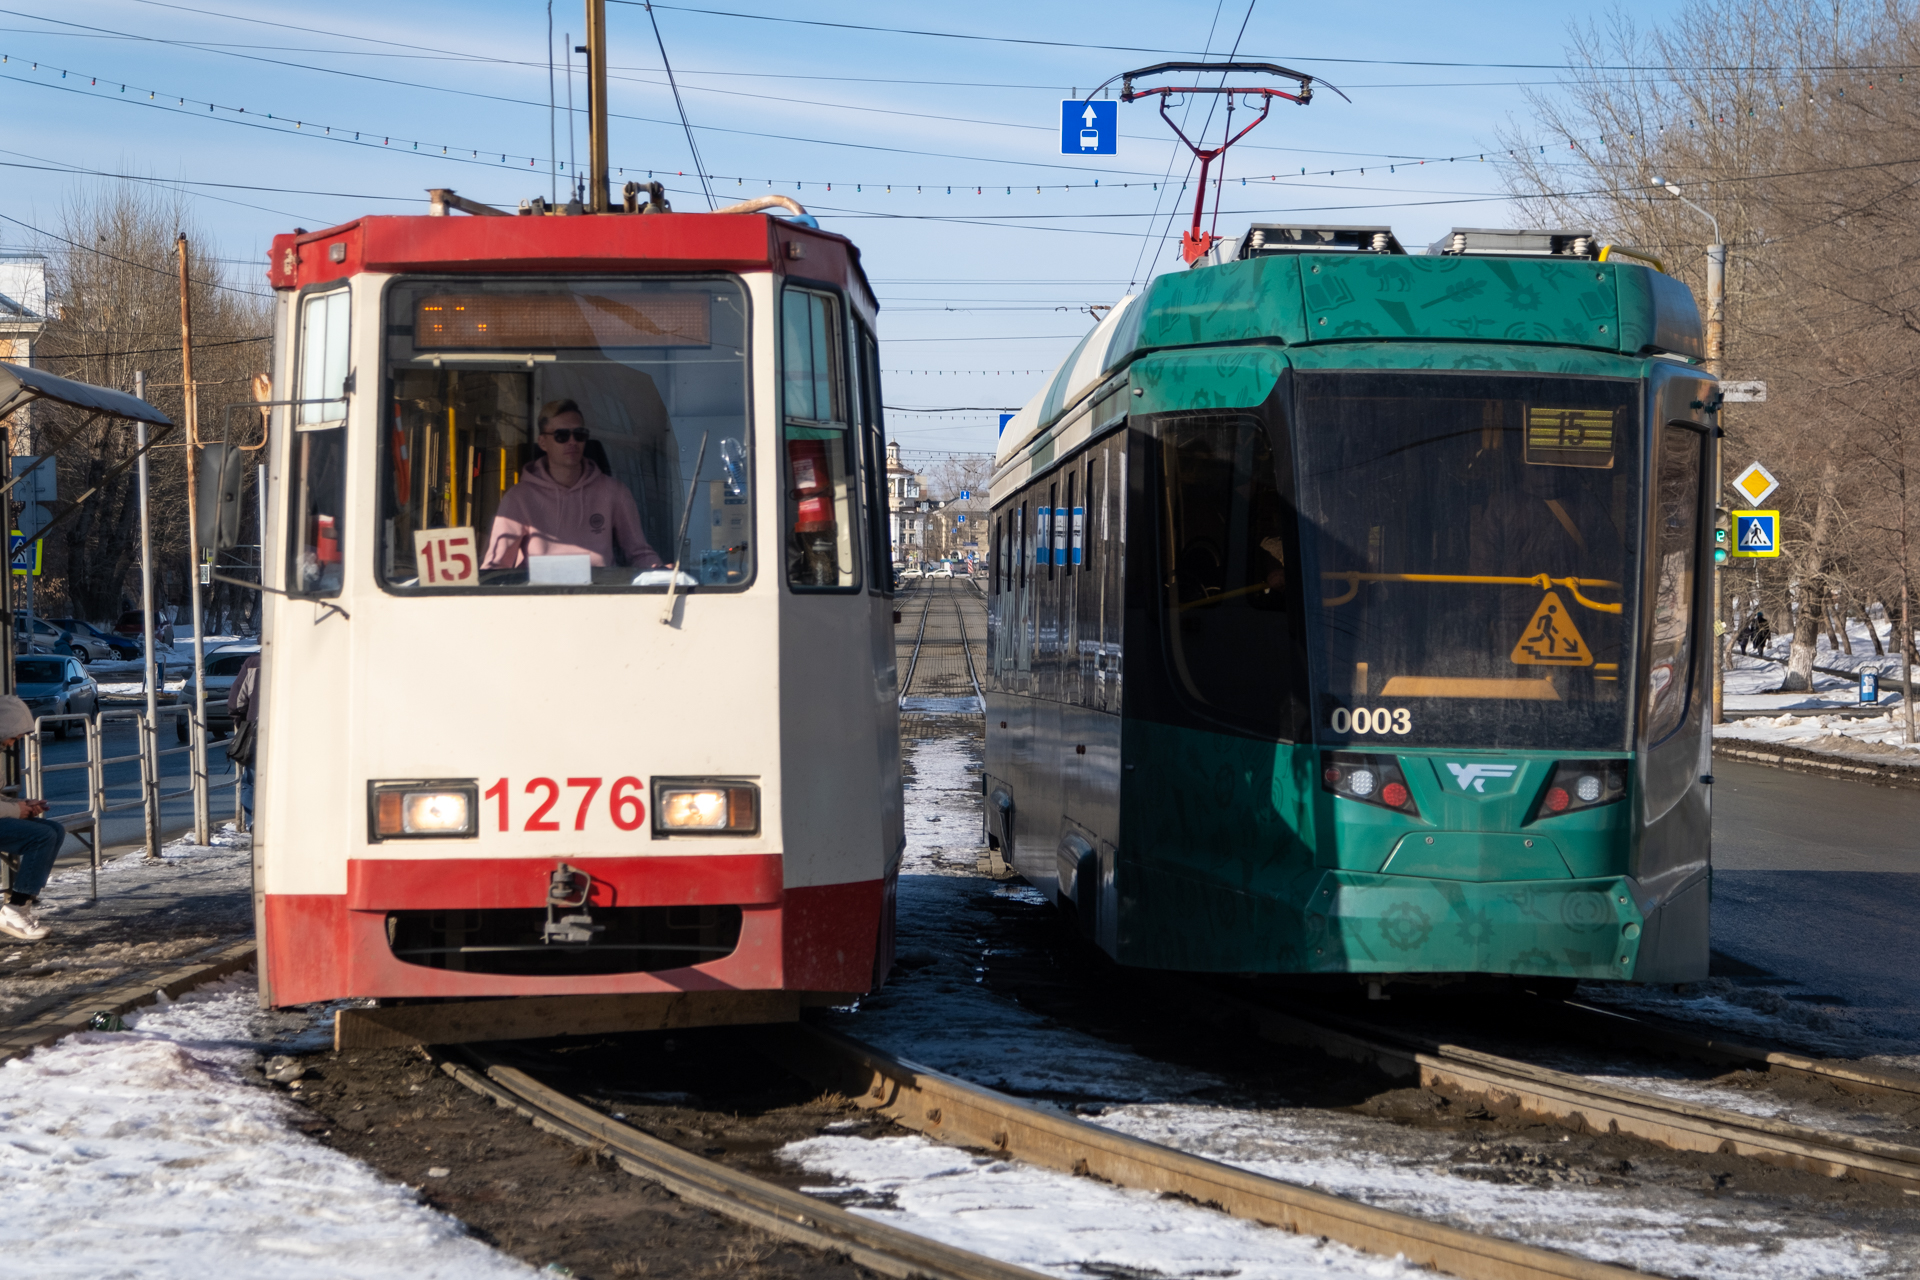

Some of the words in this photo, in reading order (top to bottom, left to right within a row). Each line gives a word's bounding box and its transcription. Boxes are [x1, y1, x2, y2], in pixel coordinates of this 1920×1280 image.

[1556, 411, 1585, 446] 15
[421, 537, 472, 583] 15
[1331, 707, 1412, 735] 0003
[485, 775, 646, 832] 1276
